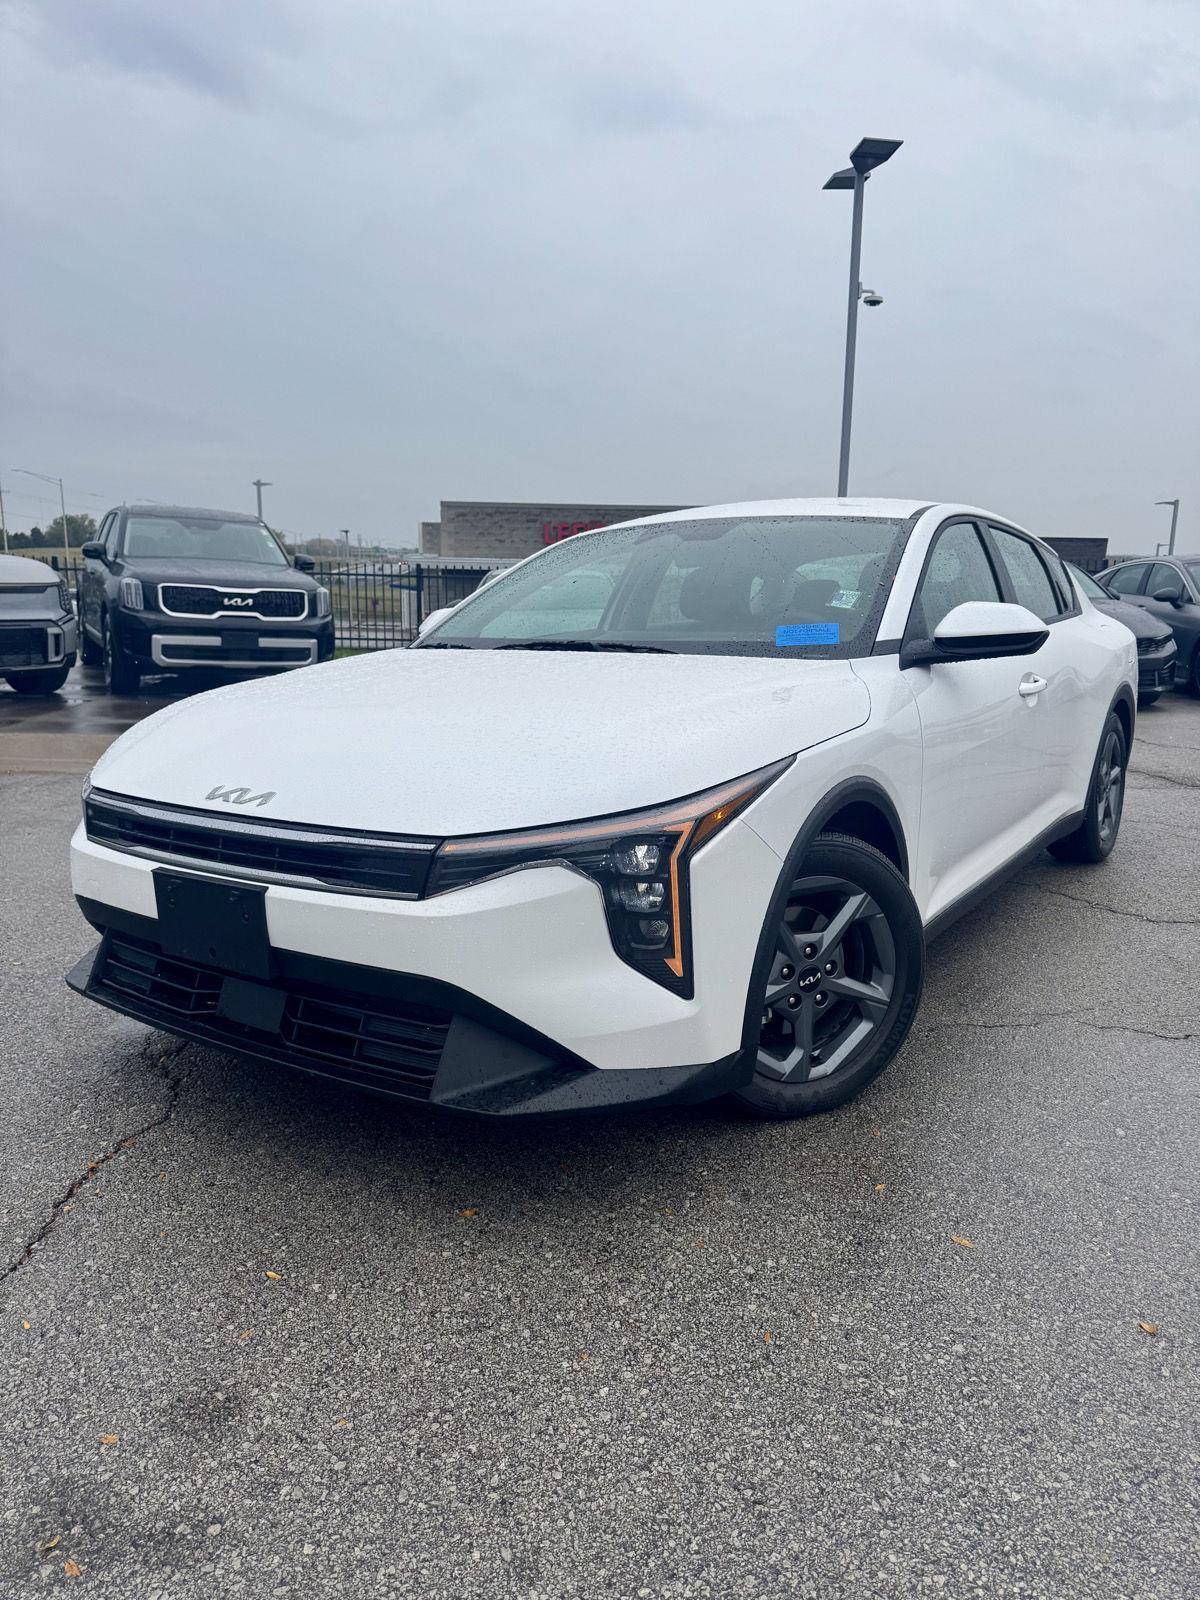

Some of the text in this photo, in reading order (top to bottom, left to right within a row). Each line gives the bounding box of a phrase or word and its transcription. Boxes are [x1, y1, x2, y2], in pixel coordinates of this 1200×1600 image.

[543, 522, 607, 544] LE
[223, 597, 253, 606] KIA
[205, 784, 277, 807] KIA
[799, 972, 821, 987] KIA
